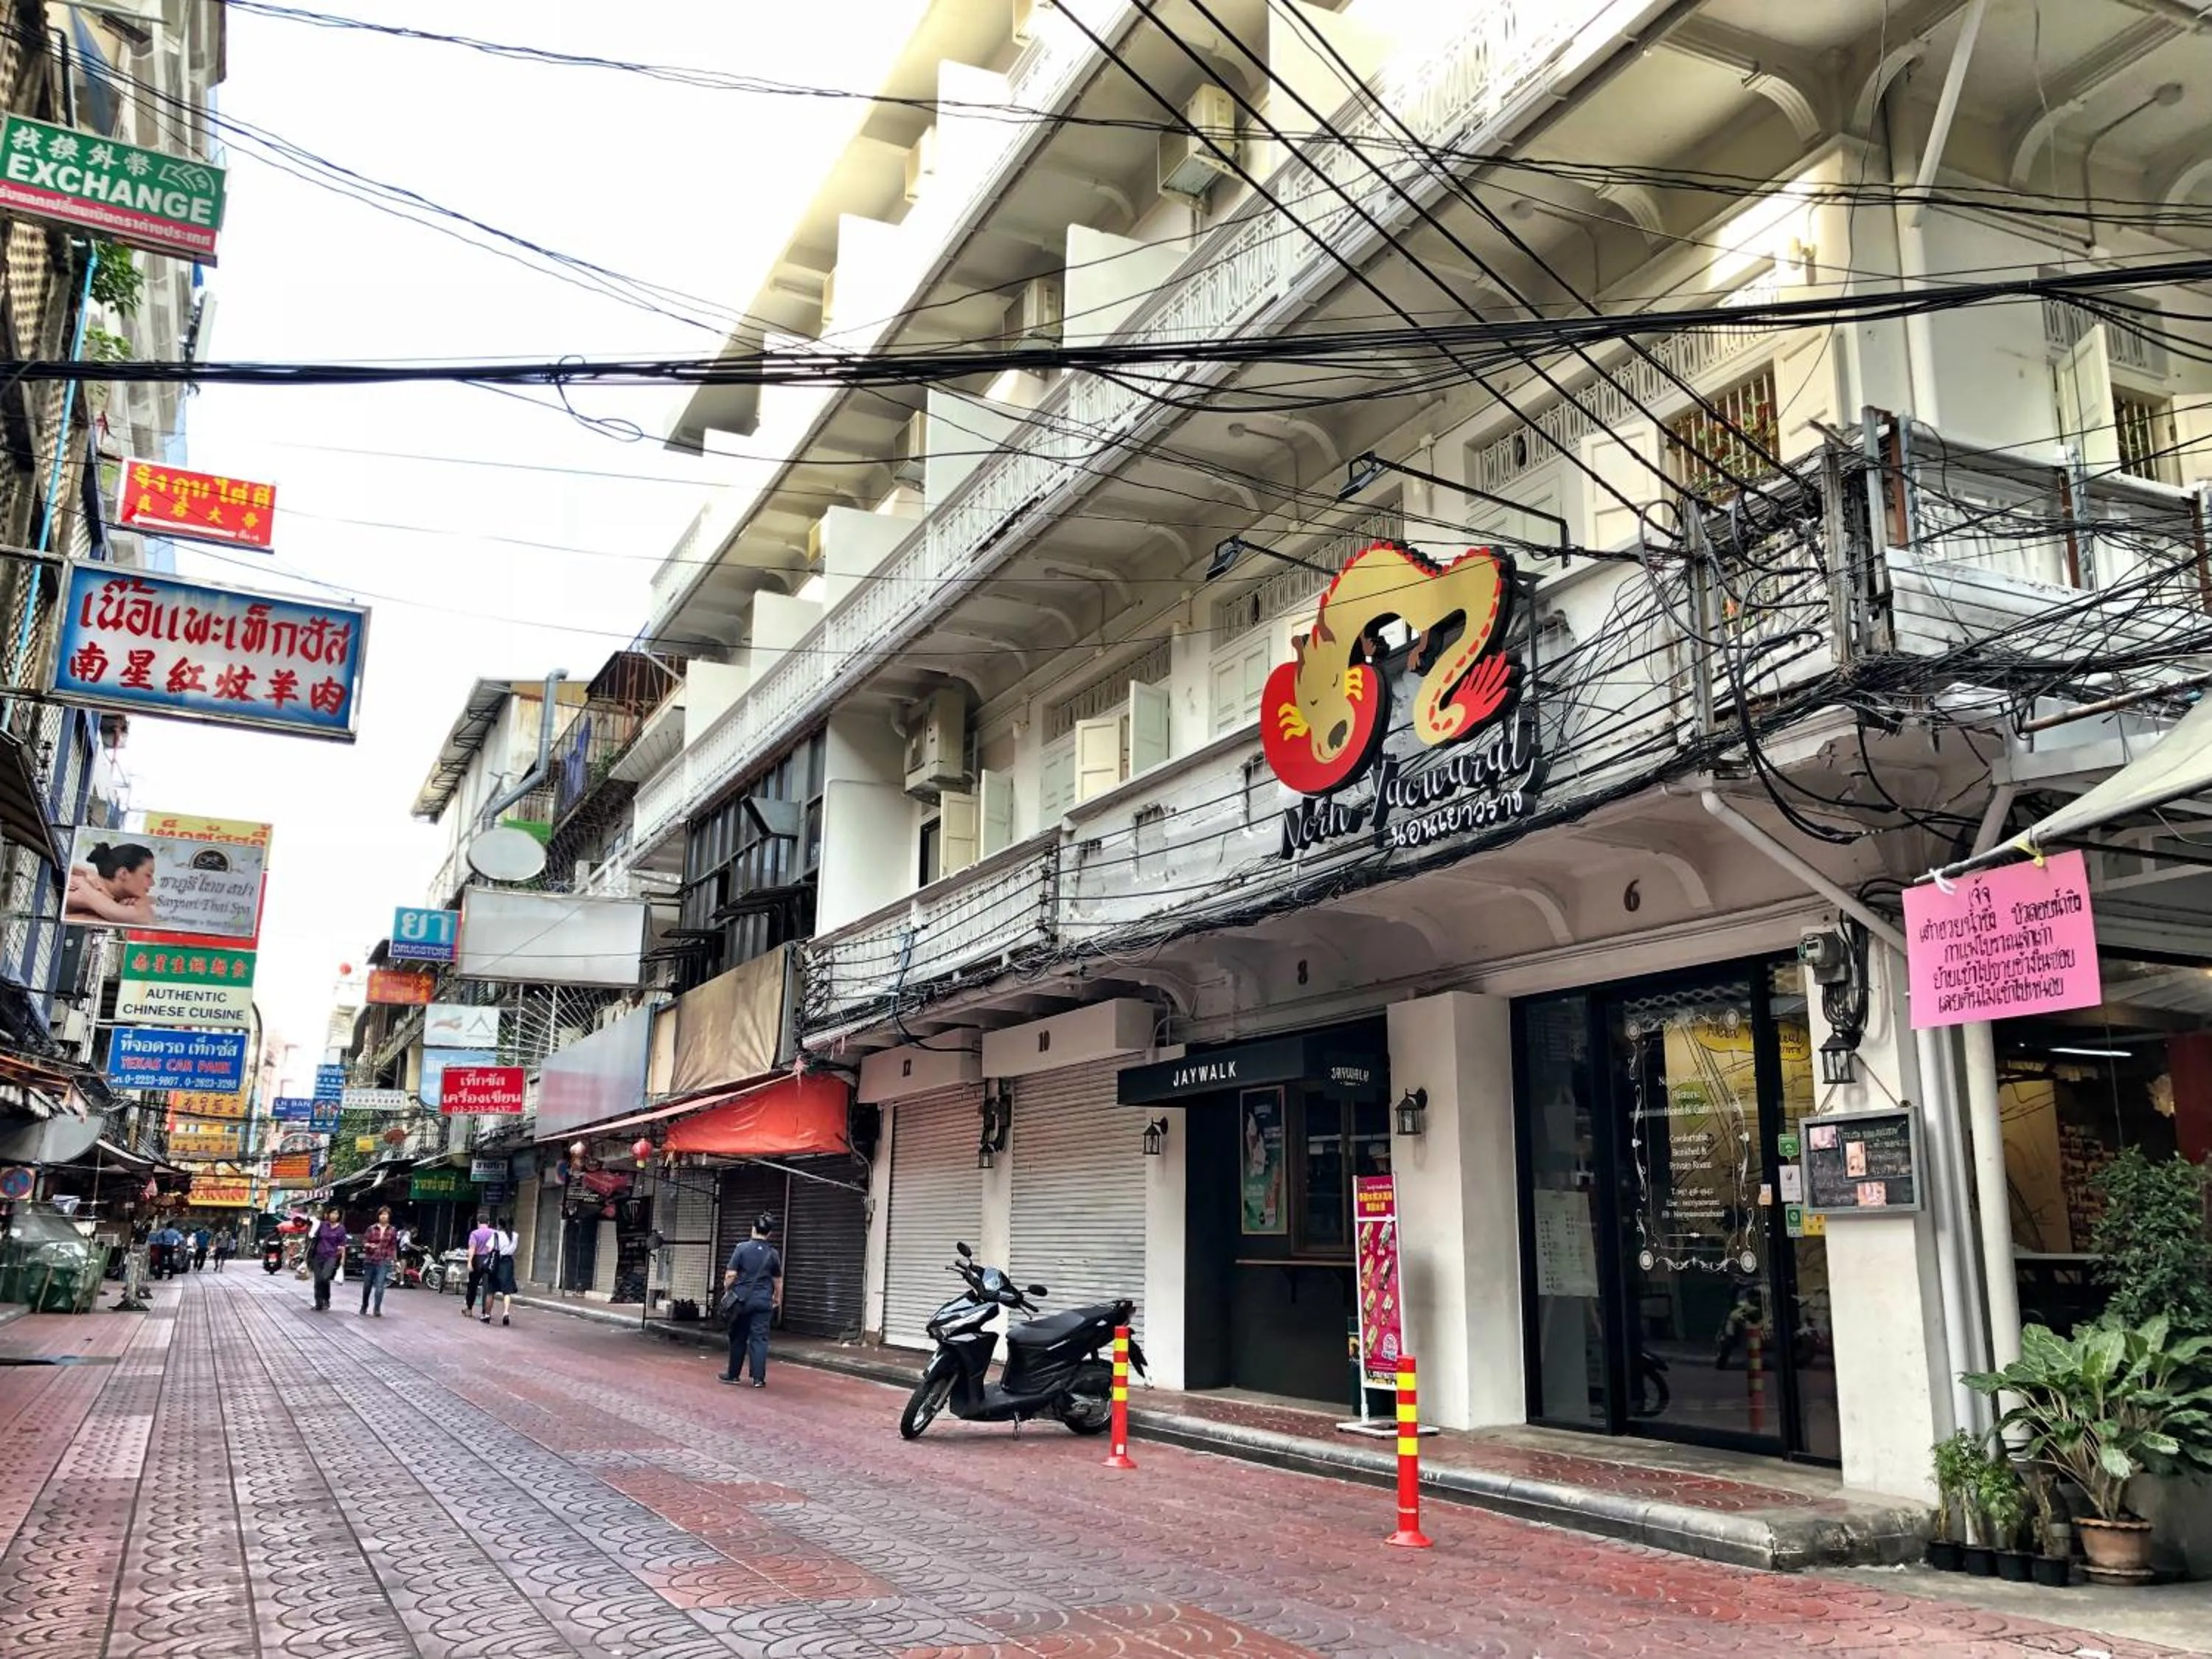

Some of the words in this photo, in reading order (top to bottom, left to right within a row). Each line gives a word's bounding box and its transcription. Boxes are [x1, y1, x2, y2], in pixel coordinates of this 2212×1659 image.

[7, 152, 213, 225] EXCHANGE
[80, 579, 352, 667] เนื้อแพะเท็กซัส
[69, 642, 347, 715] 南星紅炆羊肉
[1284, 803, 1352, 849] Norn
[1368, 706, 1532, 827] Yaowarat
[1391, 758, 1535, 846] นอนเยาวราช
[1624, 877, 1640, 912] 6
[401, 912, 451, 945] ยา
[393, 944, 452, 956] DRUGSTORE
[1298, 960, 1308, 984] 8
[146, 989, 227, 1003] AUTHENTIC
[123, 1004, 184, 1017] CHINESE
[189, 1007, 244, 1020] CUISINE
[121, 1031, 184, 1054] ที่จอดรถ
[188, 1036, 238, 1057] เท็กซัส
[1038, 1029, 1050, 1053] 10
[166, 1059, 193, 1072] CAR
[1173, 1061, 1237, 1088] JAYWALK
[460, 1073, 506, 1086] เท็กซัส
[291, 1099, 311, 1107] BAN
[443, 1088, 521, 1104] เครื่องเขียน
